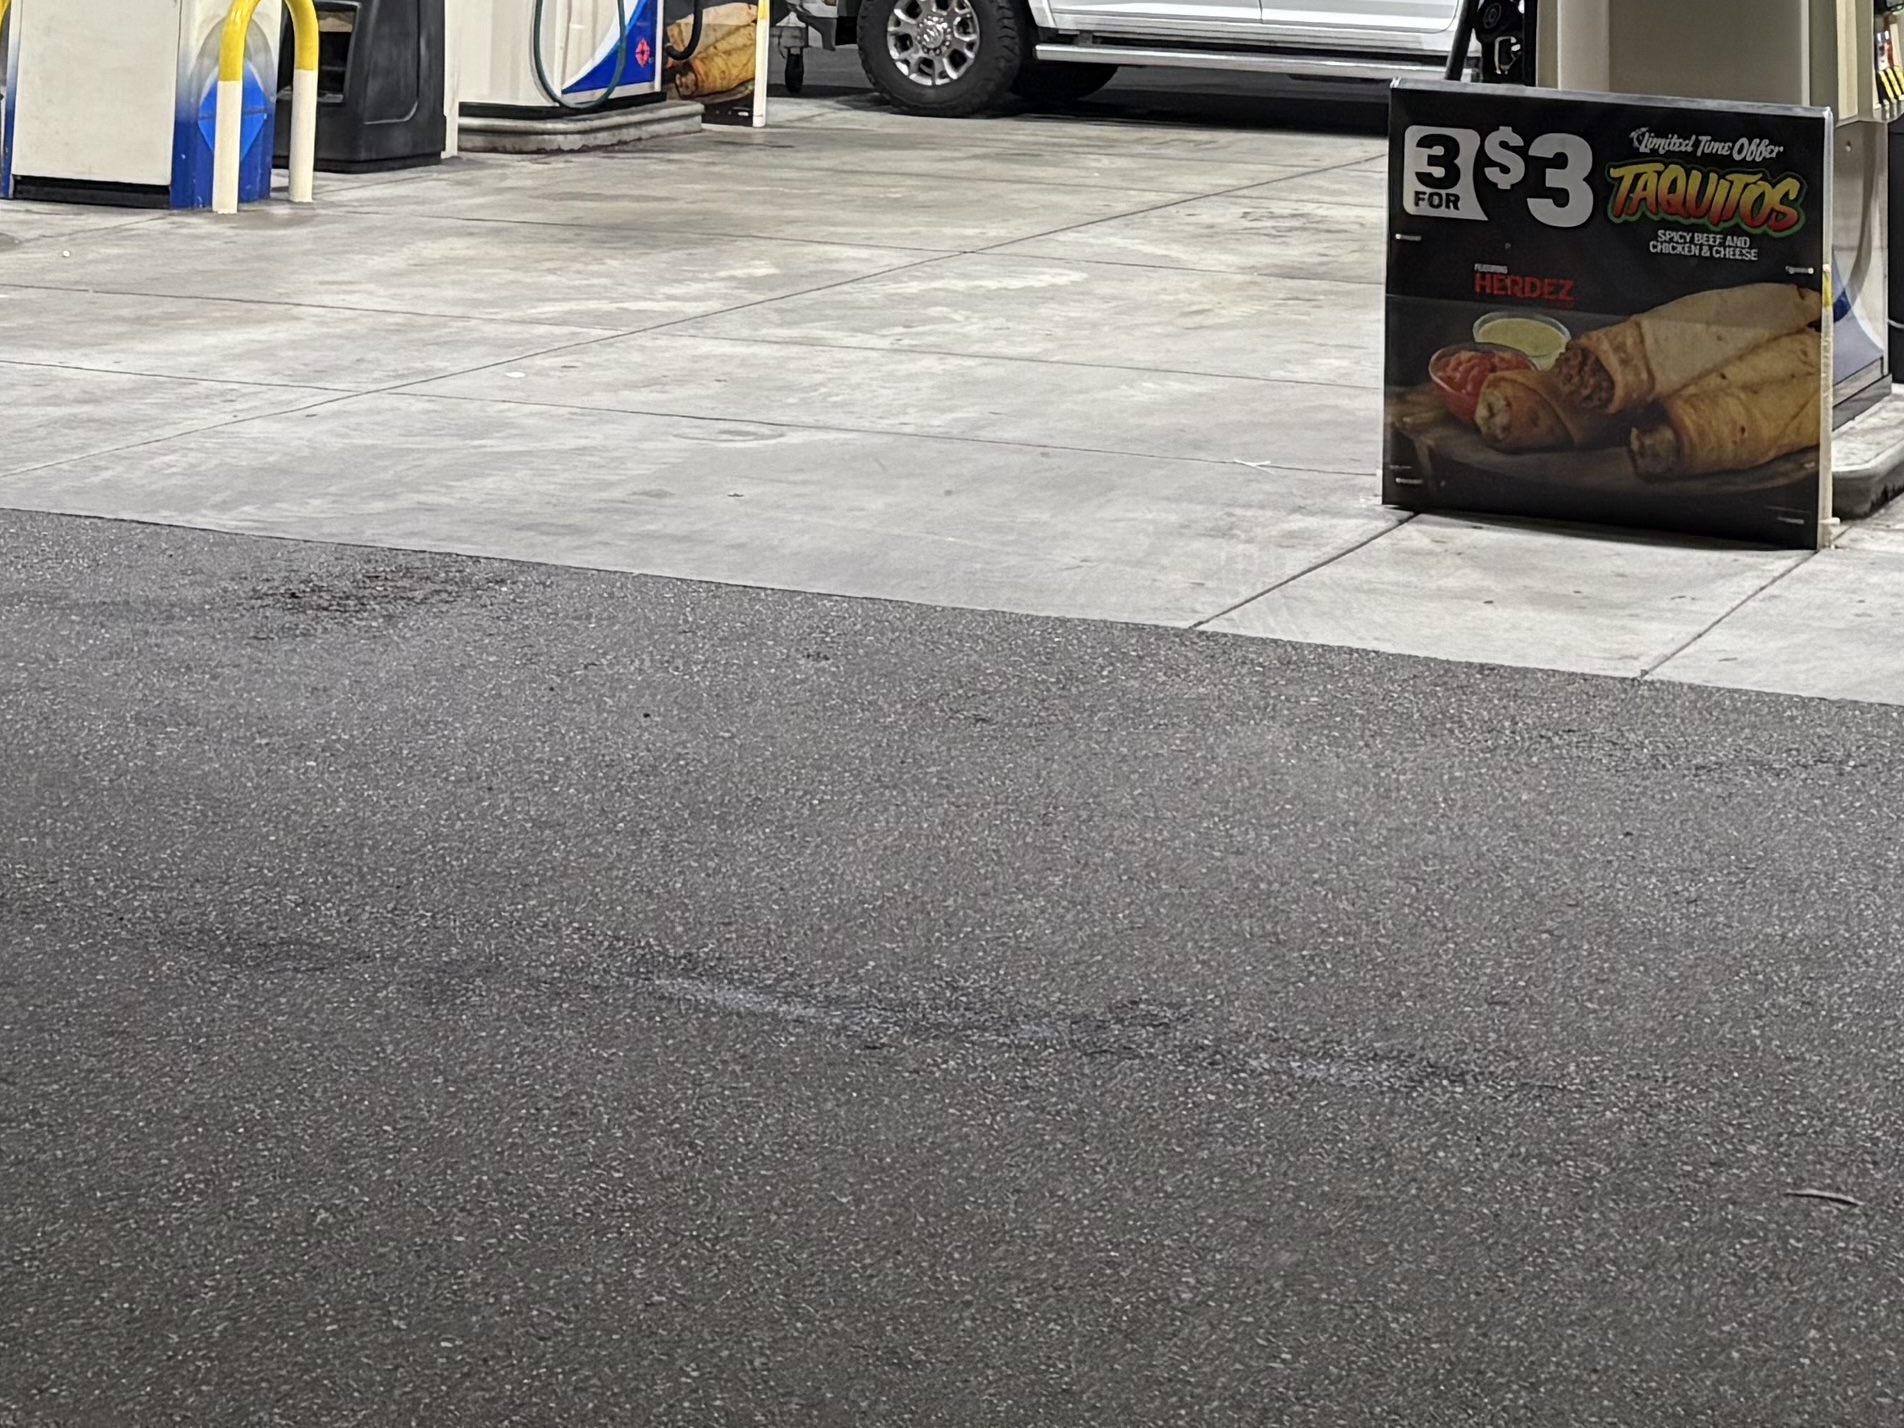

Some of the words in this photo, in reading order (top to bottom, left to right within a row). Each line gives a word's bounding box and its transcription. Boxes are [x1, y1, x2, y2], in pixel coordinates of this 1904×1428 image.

[1629, 127, 1696, 155] Limited
[1698, 135, 1733, 157] Time
[1732, 137, 1784, 162] Offer
[1415, 133, 1461, 190] 3
[1414, 191, 1460, 211] FOR
[1608, 161, 1802, 234] TAQUITOS
[1649, 241, 1699, 256] CHICKEN
[1701, 245, 1711, 257] &
[1712, 248, 1758, 261] CHEESE
[1657, 230, 1692, 244] SPICY
[1695, 233, 1723, 245] BEEF
[1725, 236, 1750, 248] AND
[1474, 273, 1575, 301] HERDEZ
